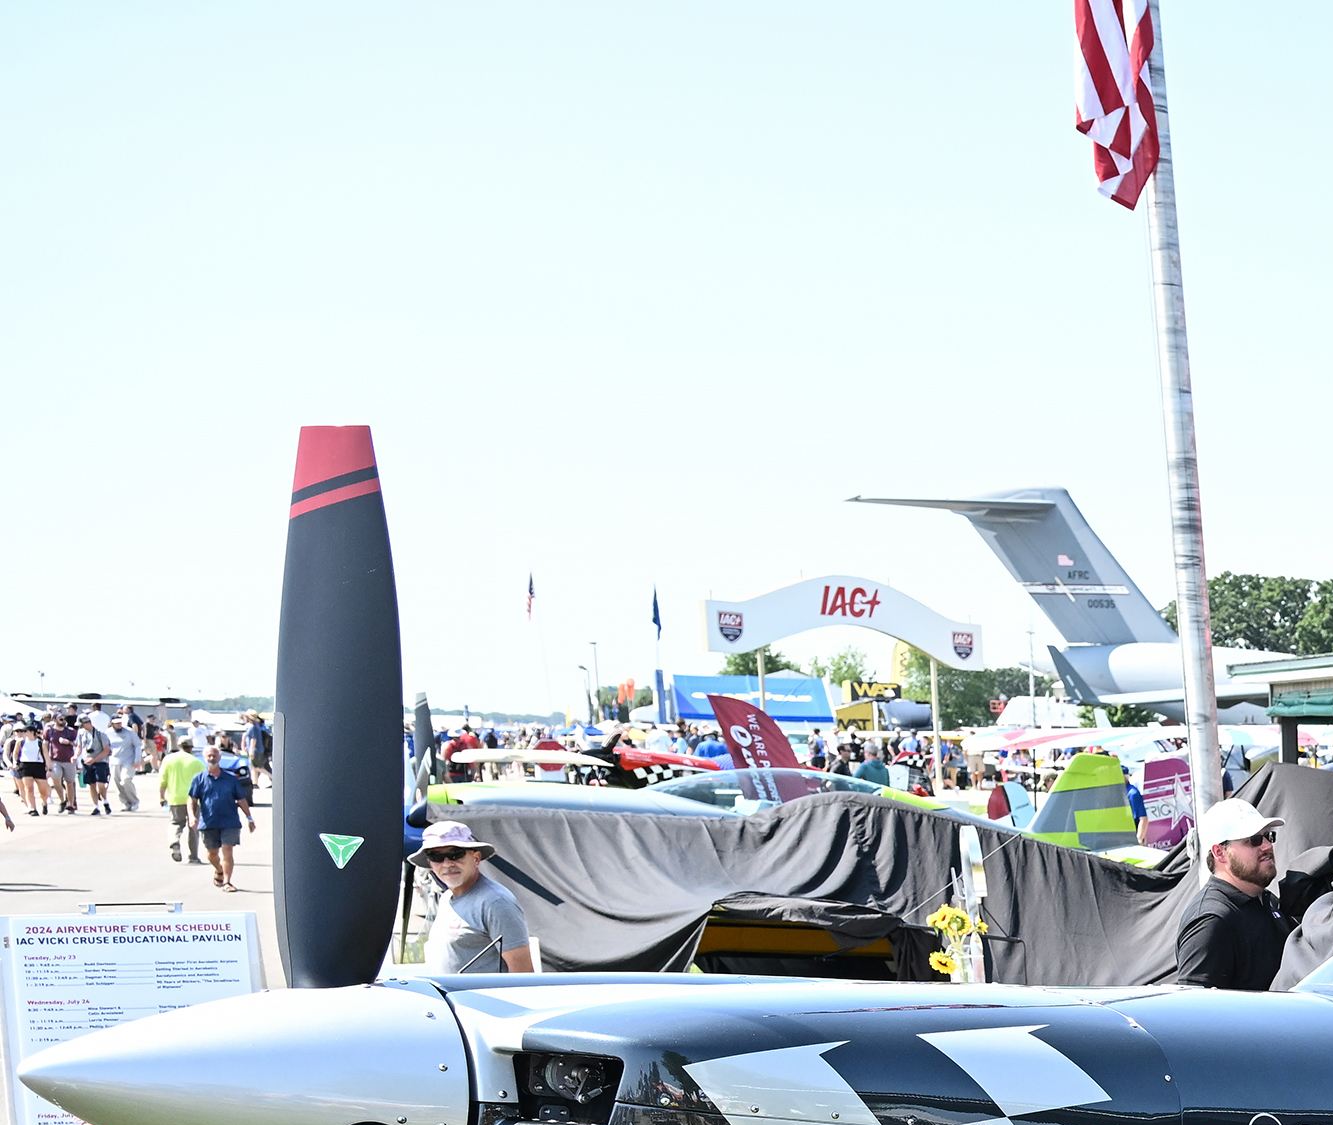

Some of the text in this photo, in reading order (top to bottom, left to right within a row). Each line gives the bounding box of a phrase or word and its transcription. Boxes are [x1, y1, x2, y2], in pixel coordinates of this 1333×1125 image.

[1067, 571, 1090, 580] AFRC
[746, 714, 760, 731] WE
[752, 734, 768, 756] ARE
[25, 926, 52, 934] 2024
[175, 923, 232, 932] SCHEDULE
[16, 934, 242, 945] IAC VICKI CRUSE EDUCATIONAL PAVILION
